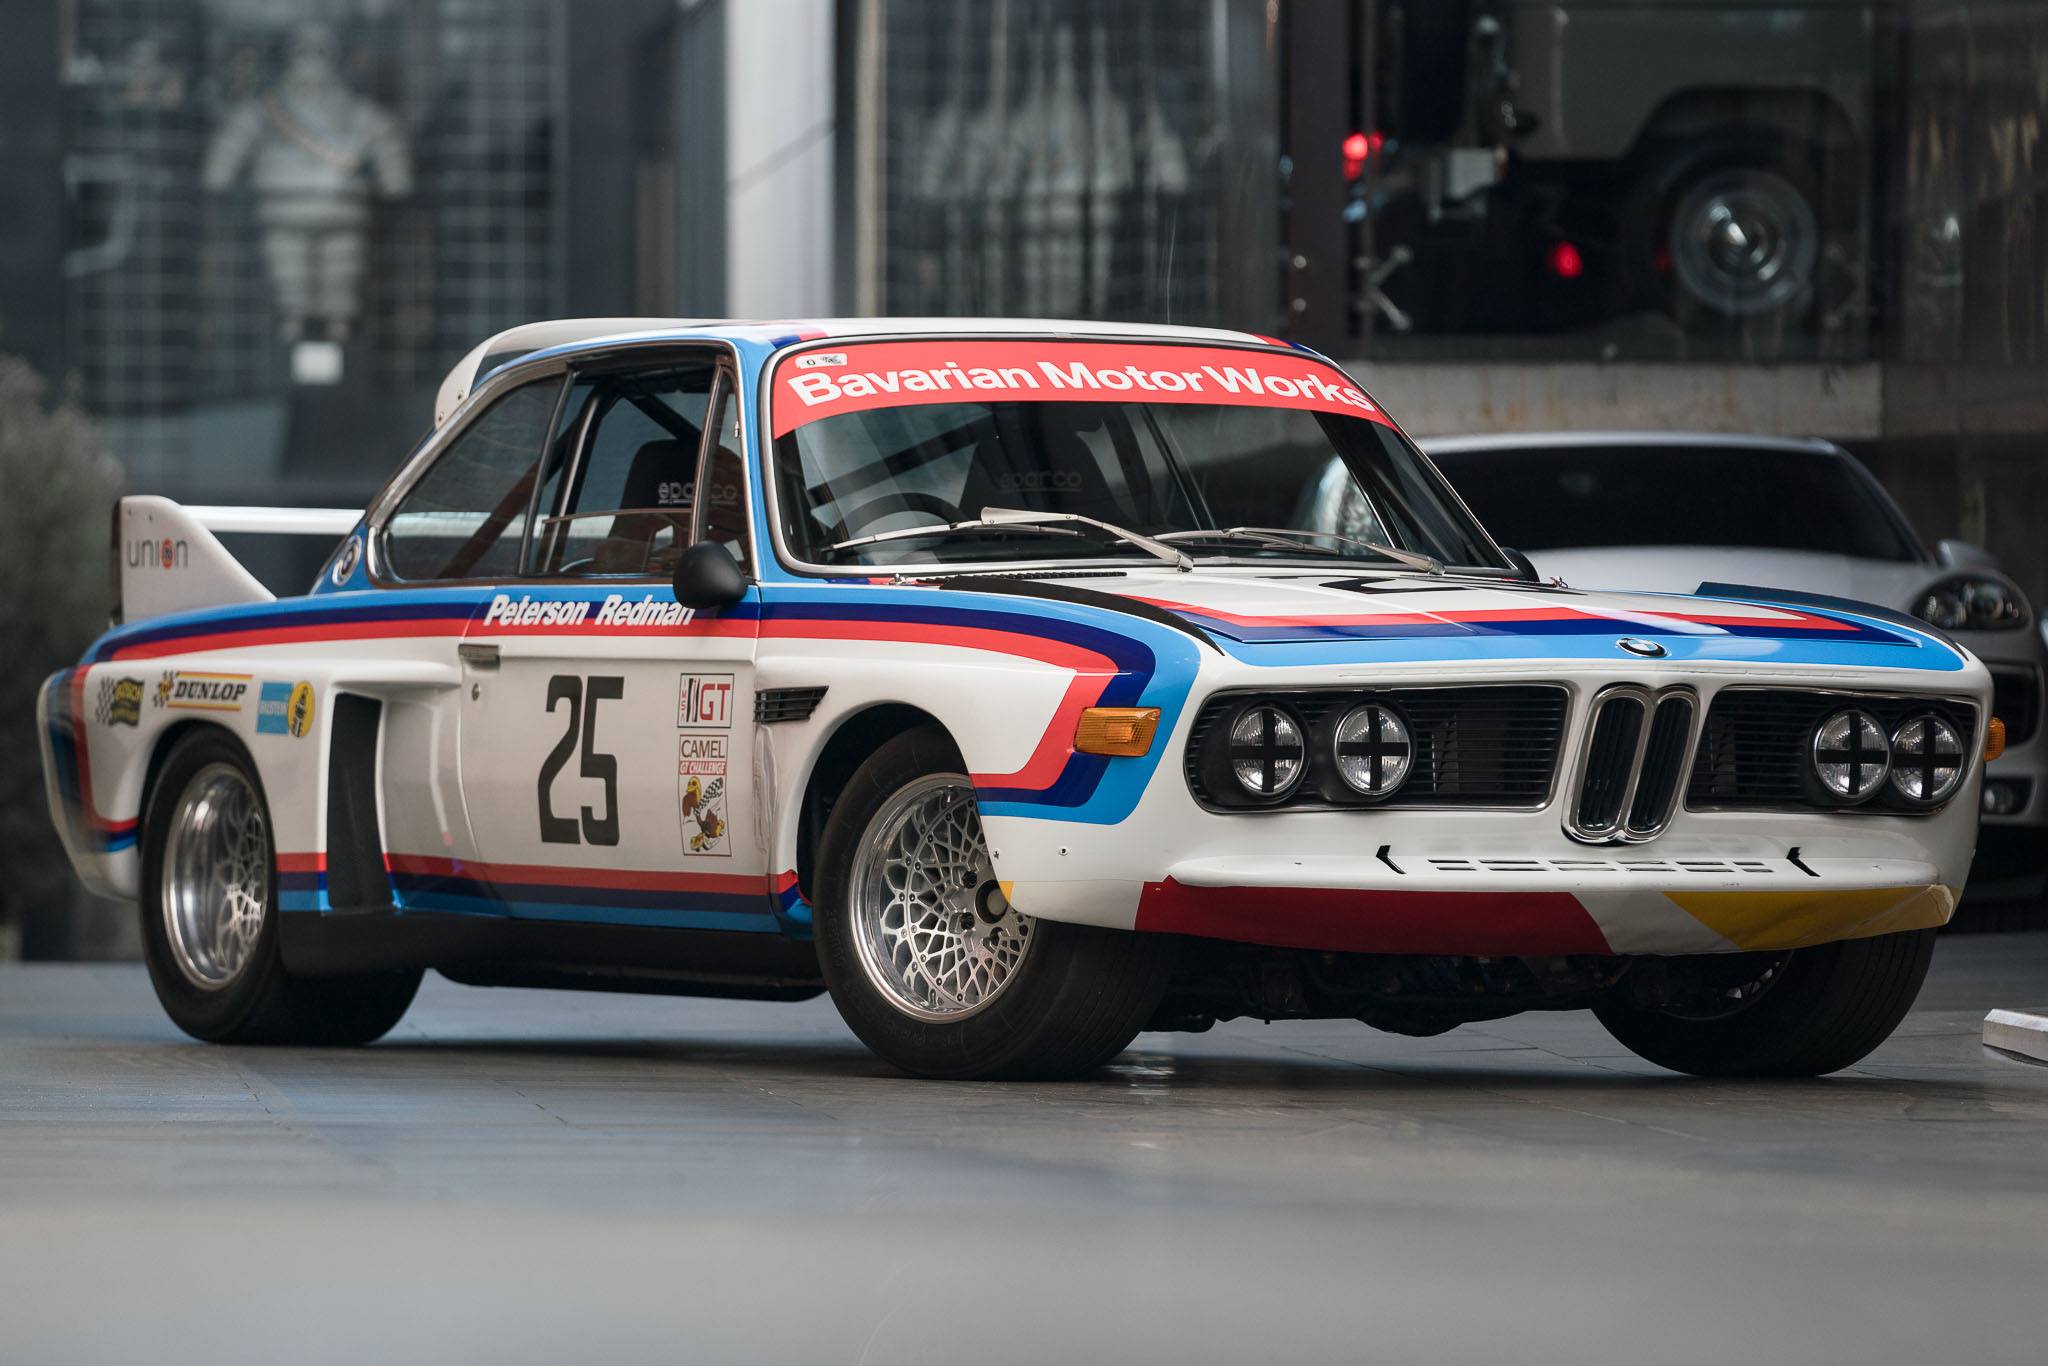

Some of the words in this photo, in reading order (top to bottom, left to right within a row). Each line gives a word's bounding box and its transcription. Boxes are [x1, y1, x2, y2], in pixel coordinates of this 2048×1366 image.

[787, 362, 1040, 407] Bavarian
[1036, 361, 1203, 392] Motor
[1200, 364, 1377, 412] Works
[126, 538, 189, 569] union
[483, 594, 591, 627] Peterson
[594, 594, 697, 627] Redman
[175, 681, 247, 701] DUNLOP
[699, 683, 731, 721] GT
[537, 674, 625, 847] 25
[681, 739, 726, 759] CAMEL
